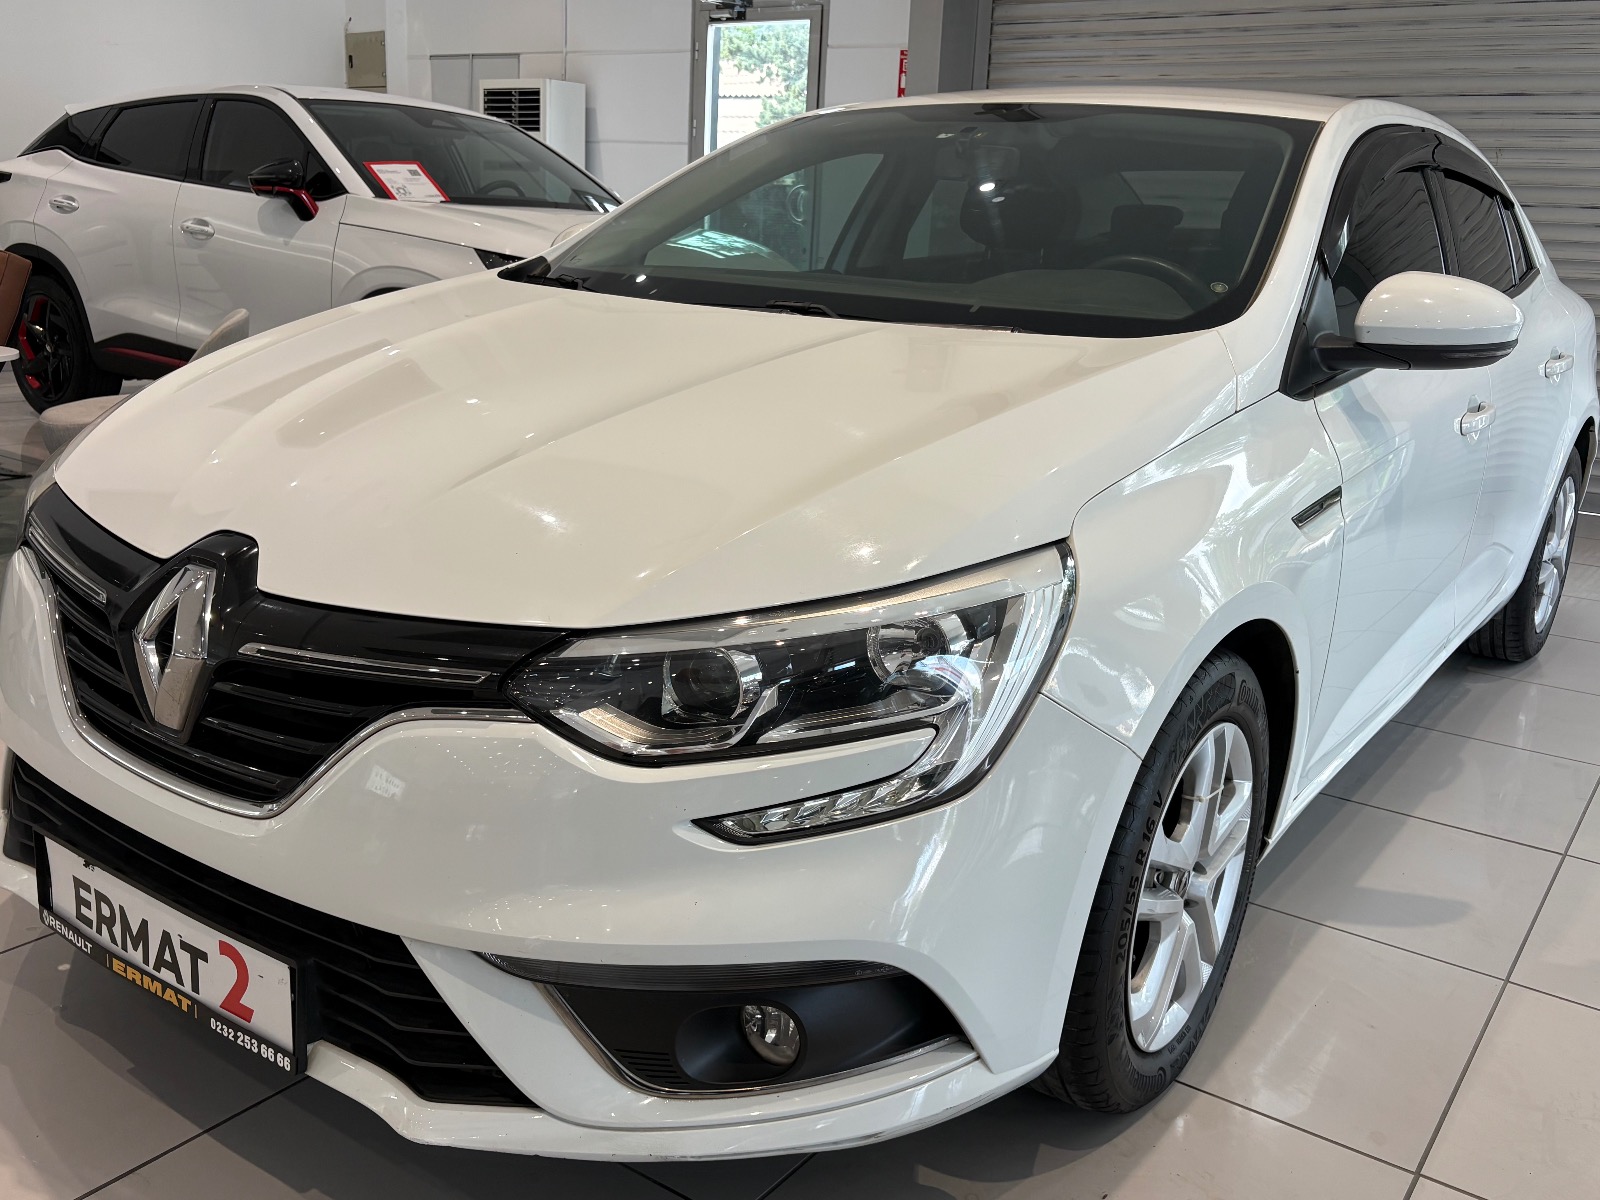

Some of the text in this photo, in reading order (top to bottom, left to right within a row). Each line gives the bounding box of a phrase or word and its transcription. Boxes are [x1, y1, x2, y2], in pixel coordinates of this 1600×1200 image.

[72, 875, 255, 1023] ERMAT 2
[1116, 788, 1164, 966] 205/55 R 16 V
[49, 915, 291, 1072] RENAULT ERMAT 0232 253 66 66
